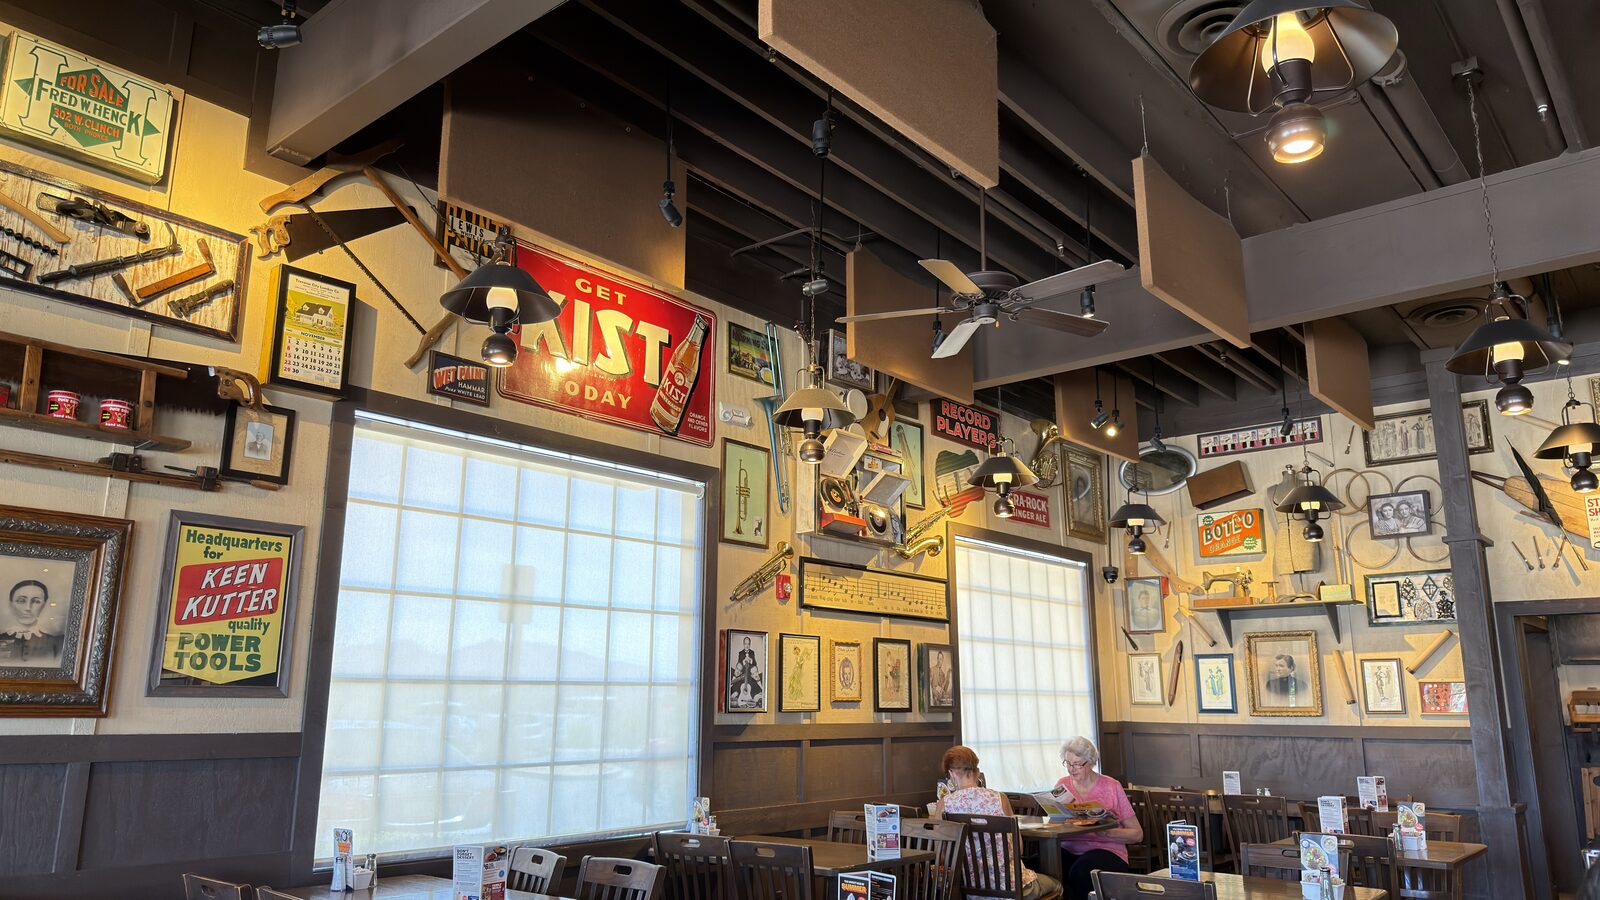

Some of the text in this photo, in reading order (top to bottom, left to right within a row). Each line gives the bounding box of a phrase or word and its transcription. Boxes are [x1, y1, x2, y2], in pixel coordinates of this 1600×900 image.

[60, 72, 124, 108] FOR SALE
[36, 78, 78, 108] FRED
[92, 103, 142, 136] HENCK
[451, 216, 484, 238] LEWIS
[575, 278, 627, 305] GET
[300, 332, 325, 340] NOVEMBER
[521, 290, 670, 387] KIST
[434, 366, 487, 390] WET PAINT
[458, 382, 486, 394] HAMMAR
[557, 378, 632, 409] ODAY
[663, 378, 686, 404] KIST
[689, 412, 706, 420] ORANGE
[942, 400, 990, 430] RECORD
[937, 416, 996, 448] PLAYERS
[1010, 492, 1047, 512] RA-ROCK
[1036, 514, 1046, 524] ALE
[186, 529, 282, 552] Headquarters
[203, 546, 224, 560] for
[200, 562, 270, 590] KEEN
[182, 588, 277, 620] KUTTER
[228, 618, 270, 636] quality
[178, 632, 262, 652] POWER
[174, 652, 262, 672] TOOLS
[842, 882, 868, 894] SUMMER
